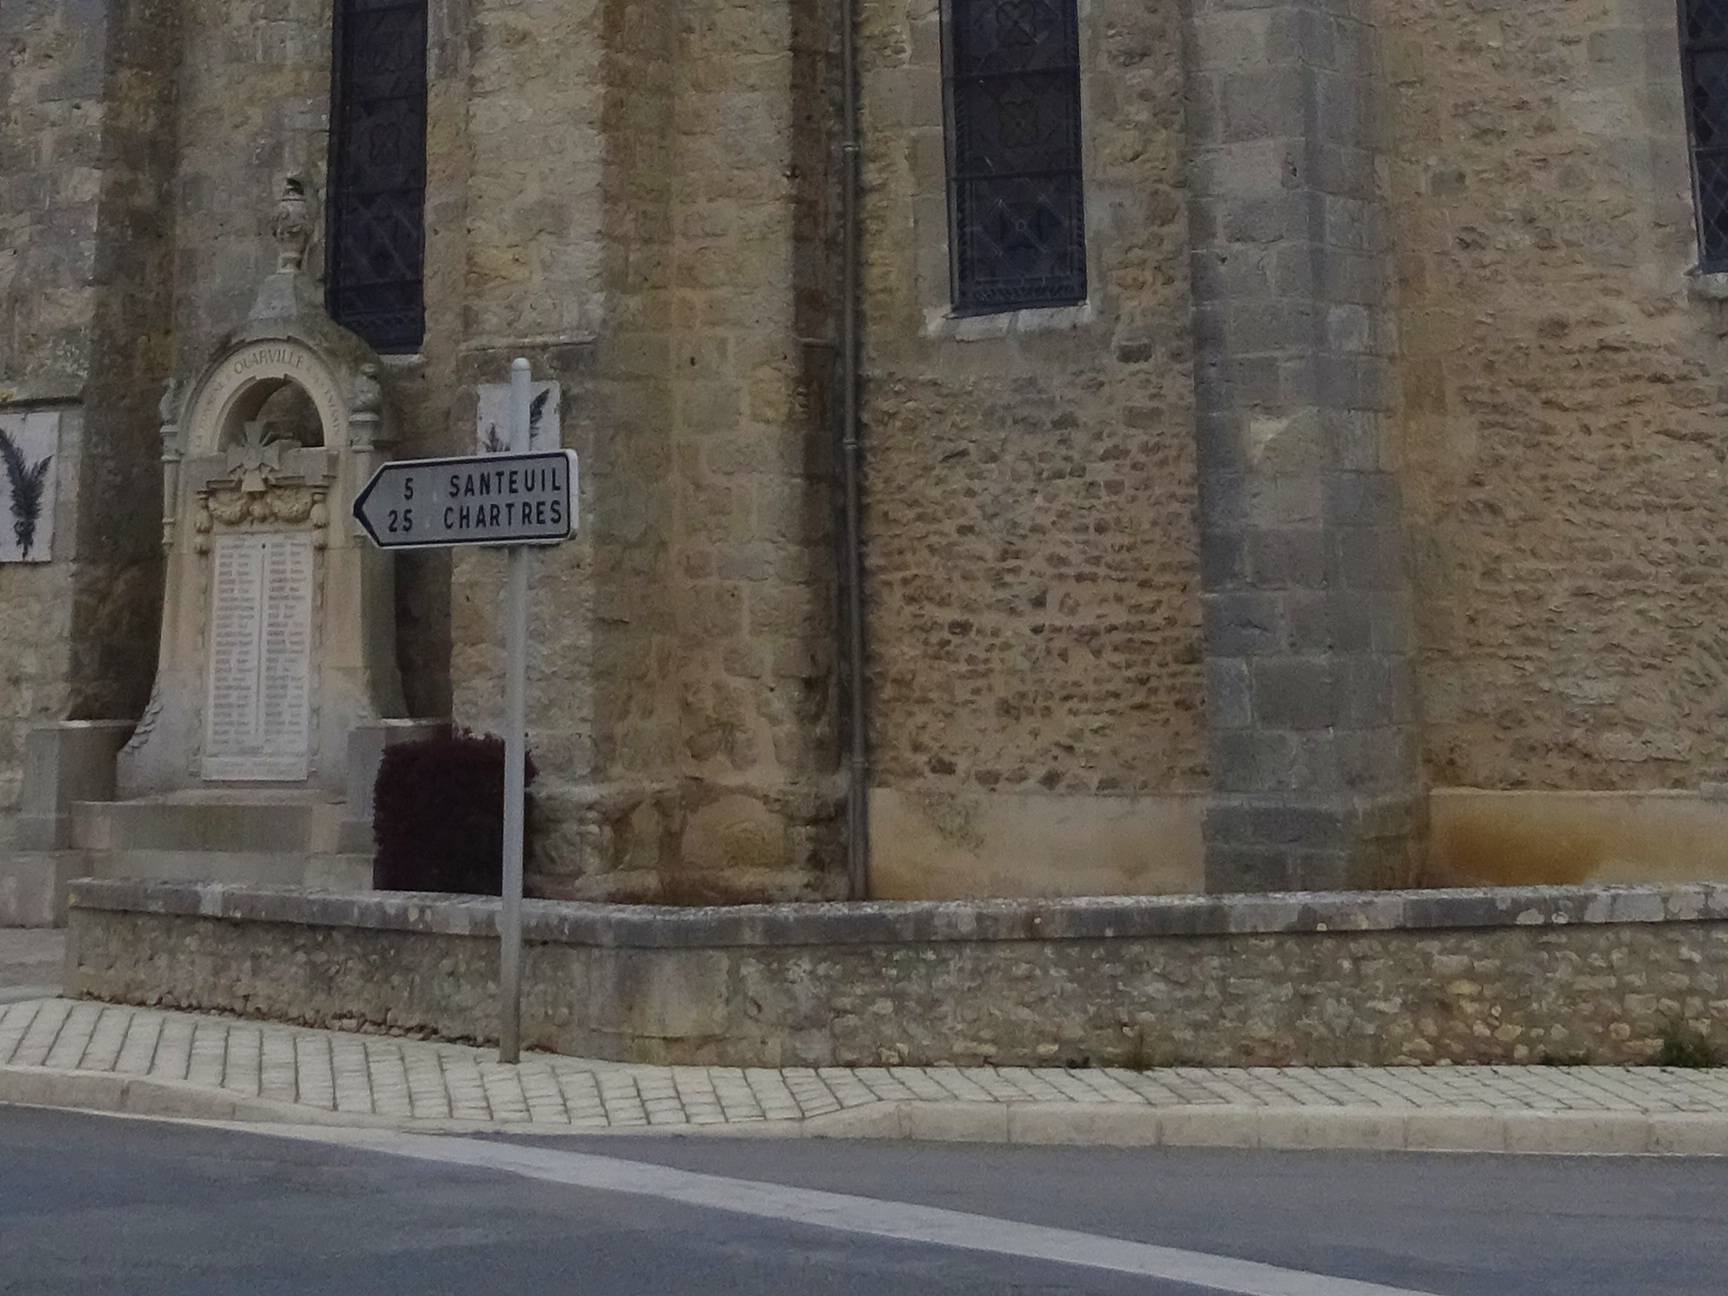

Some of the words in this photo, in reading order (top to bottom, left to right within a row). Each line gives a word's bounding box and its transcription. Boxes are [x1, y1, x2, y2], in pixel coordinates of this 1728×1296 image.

[403, 477, 414, 501] 5
[448, 467, 562, 498] SANTEUIL
[387, 509, 414, 533] 25
[443, 500, 563, 529] CHARTRES
